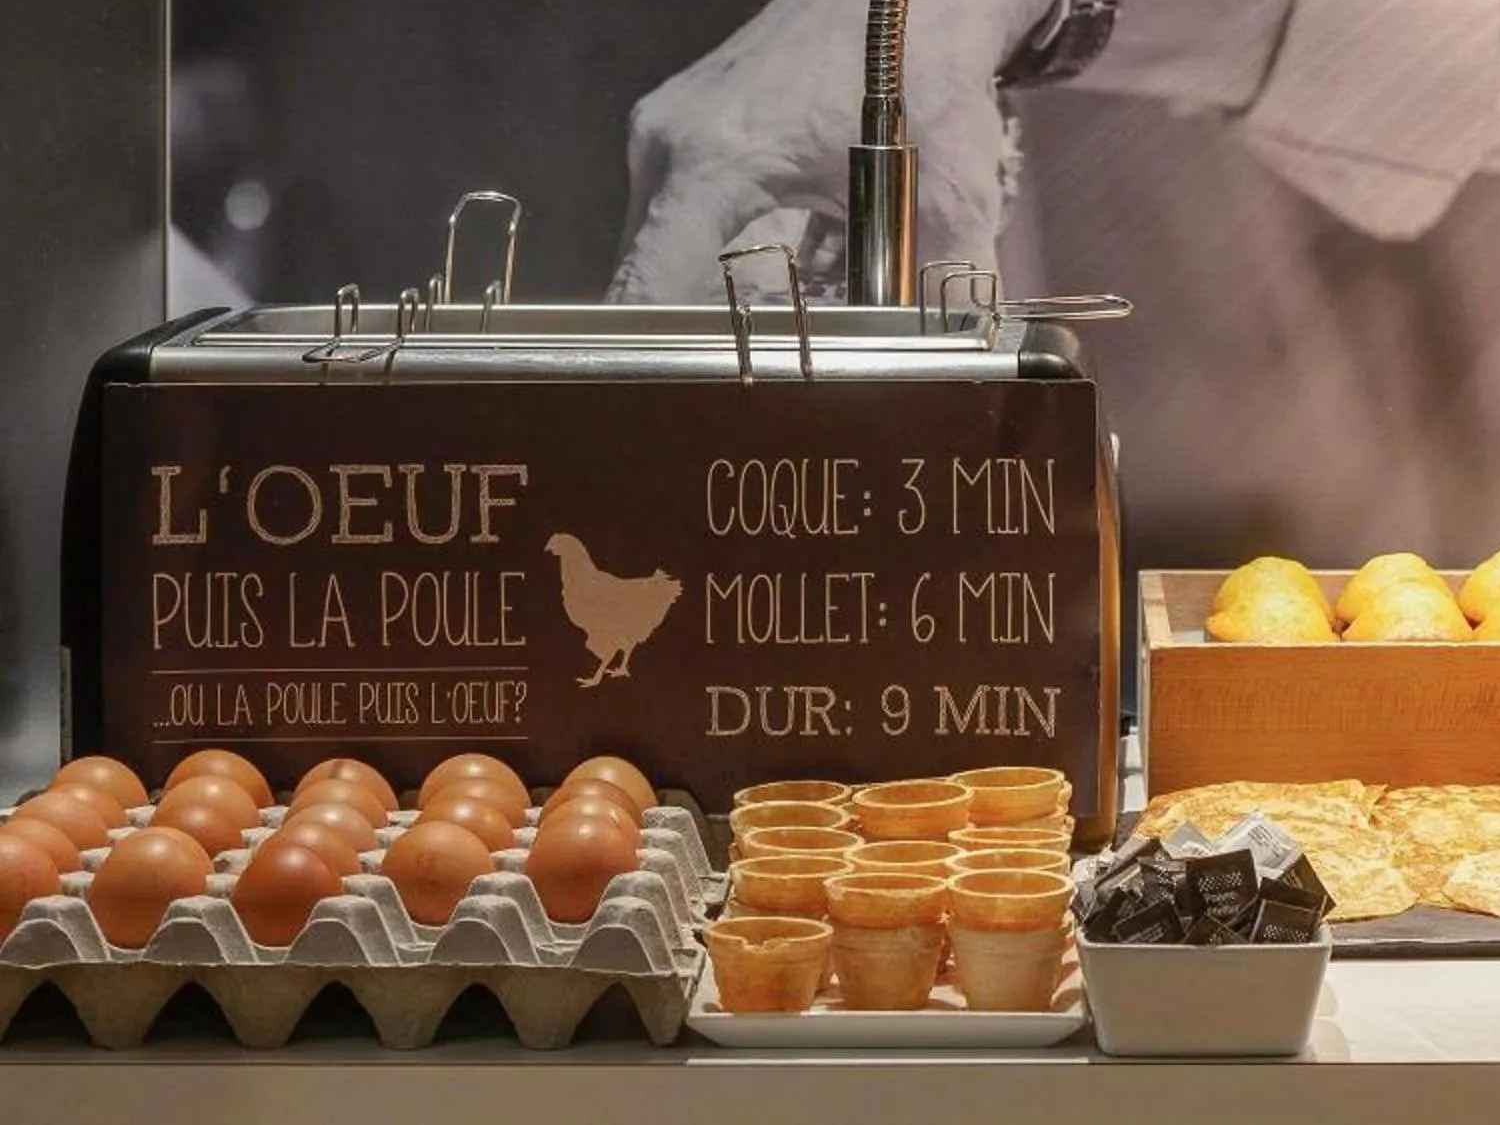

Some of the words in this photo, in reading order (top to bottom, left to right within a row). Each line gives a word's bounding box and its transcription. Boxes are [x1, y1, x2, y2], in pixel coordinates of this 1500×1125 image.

[151, 464, 529, 546] L'OEUF
[706, 458, 872, 538] COQUE:
[898, 458, 926, 535] 3
[951, 457, 1056, 535] MIN
[152, 572, 265, 650] PUIS
[289, 572, 356, 649] LA
[381, 571, 527, 648] POULE
[706, 572, 887, 644] MOLLET:
[911, 572, 935, 643] 6
[958, 572, 1056, 644] MIN
[216, 683, 253, 726] LA
[266, 682, 347, 725] POULE
[359, 681, 419, 725] PUIS
[430, 680, 528, 725] L'OEUF?
[705, 685, 853, 737] DUR:
[881, 684, 911, 736] 9
[933, 685, 1061, 738] MIN
